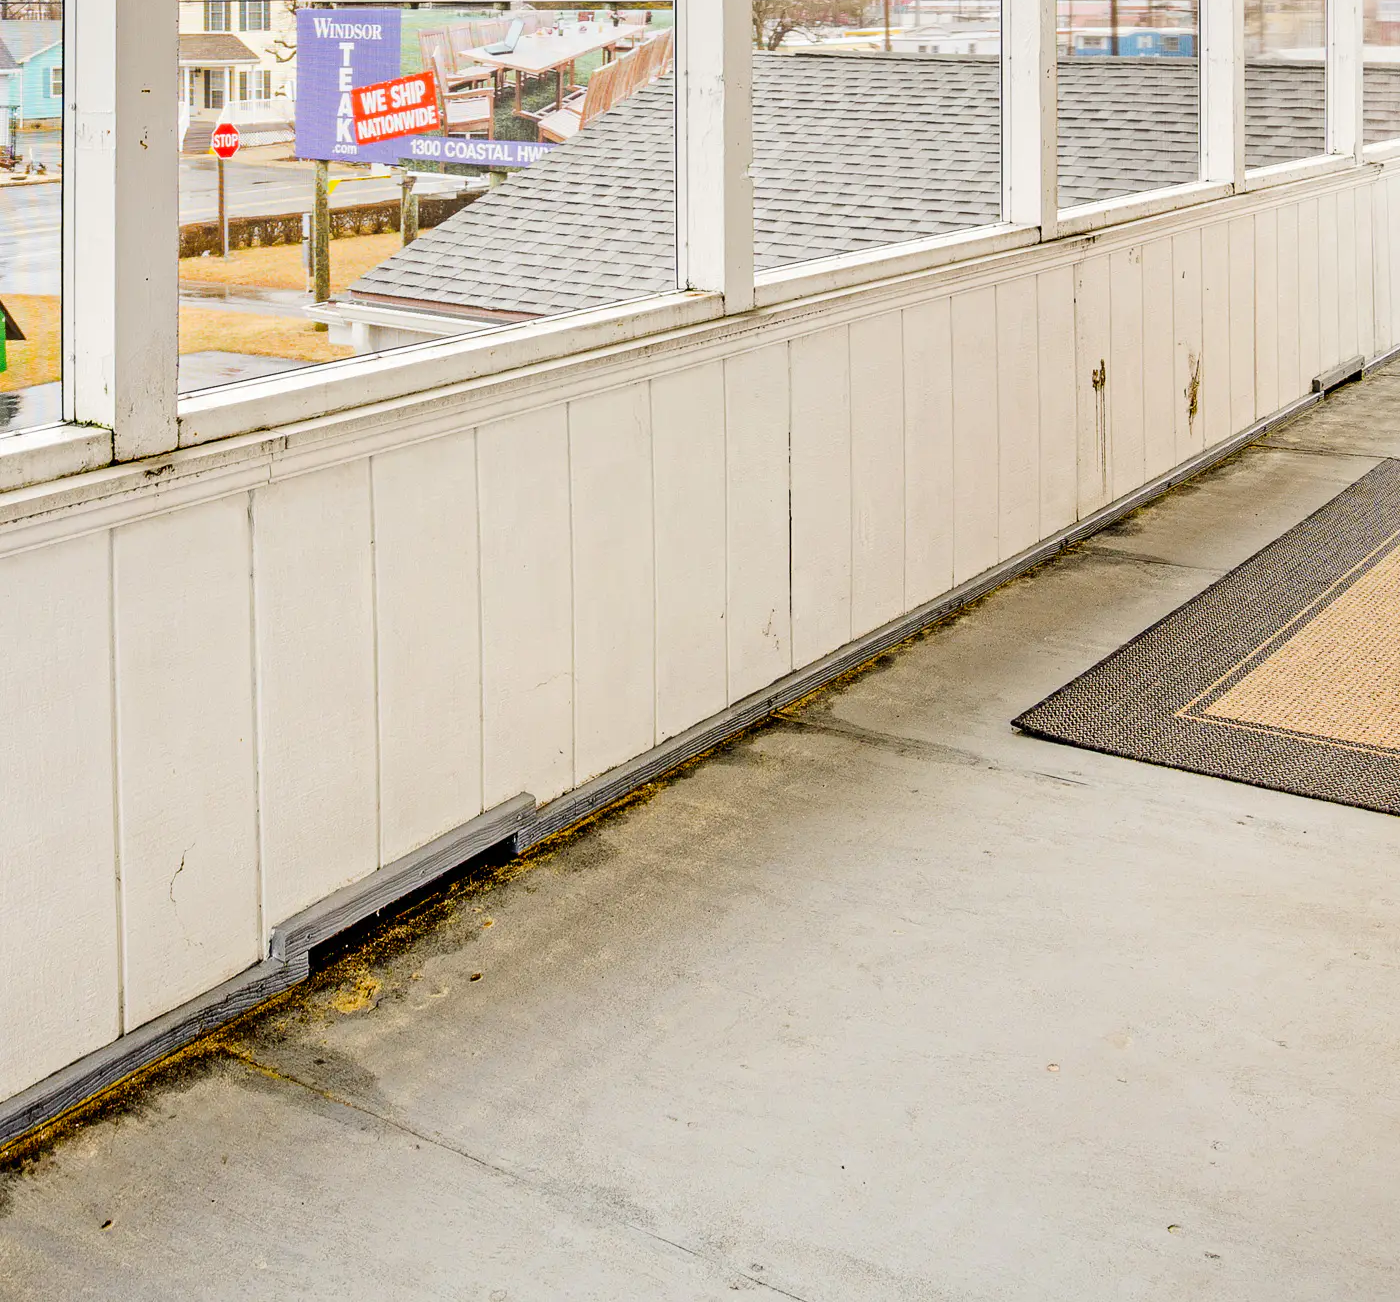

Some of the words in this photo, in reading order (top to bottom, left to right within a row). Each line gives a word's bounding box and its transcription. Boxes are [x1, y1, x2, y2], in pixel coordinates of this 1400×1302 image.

[336, 42, 355, 142] TEAK
[360, 88, 387, 115] WE
[390, 80, 426, 108] SHIP
[357, 105, 437, 140] NATIONWIDE
[213, 133, 238, 148] STOP
[332, 144, 358, 155] .com
[410, 139, 441, 156] 1300
[445, 142, 513, 162] COASTAL
